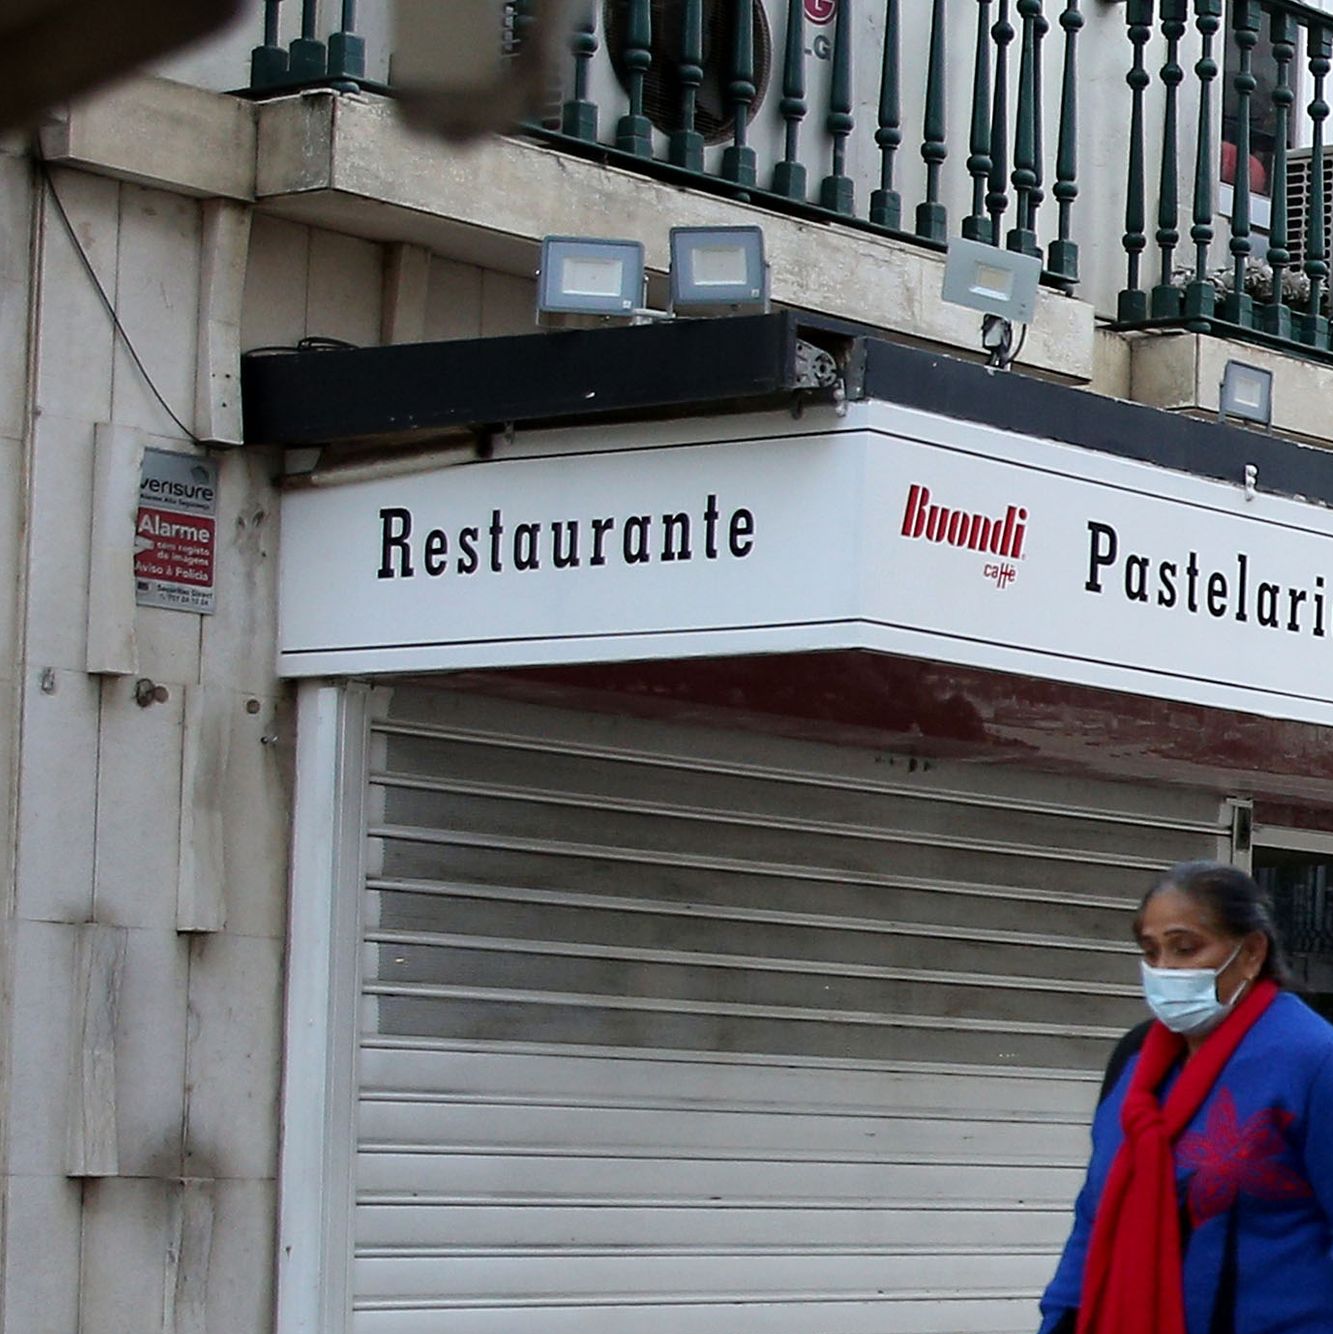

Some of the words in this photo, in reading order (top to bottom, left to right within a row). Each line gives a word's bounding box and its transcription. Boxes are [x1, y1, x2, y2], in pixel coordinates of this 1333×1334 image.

[138, 514, 210, 543] Alarme
[377, 494, 755, 579] Restaurante
[901, 484, 1027, 559] Buondi
